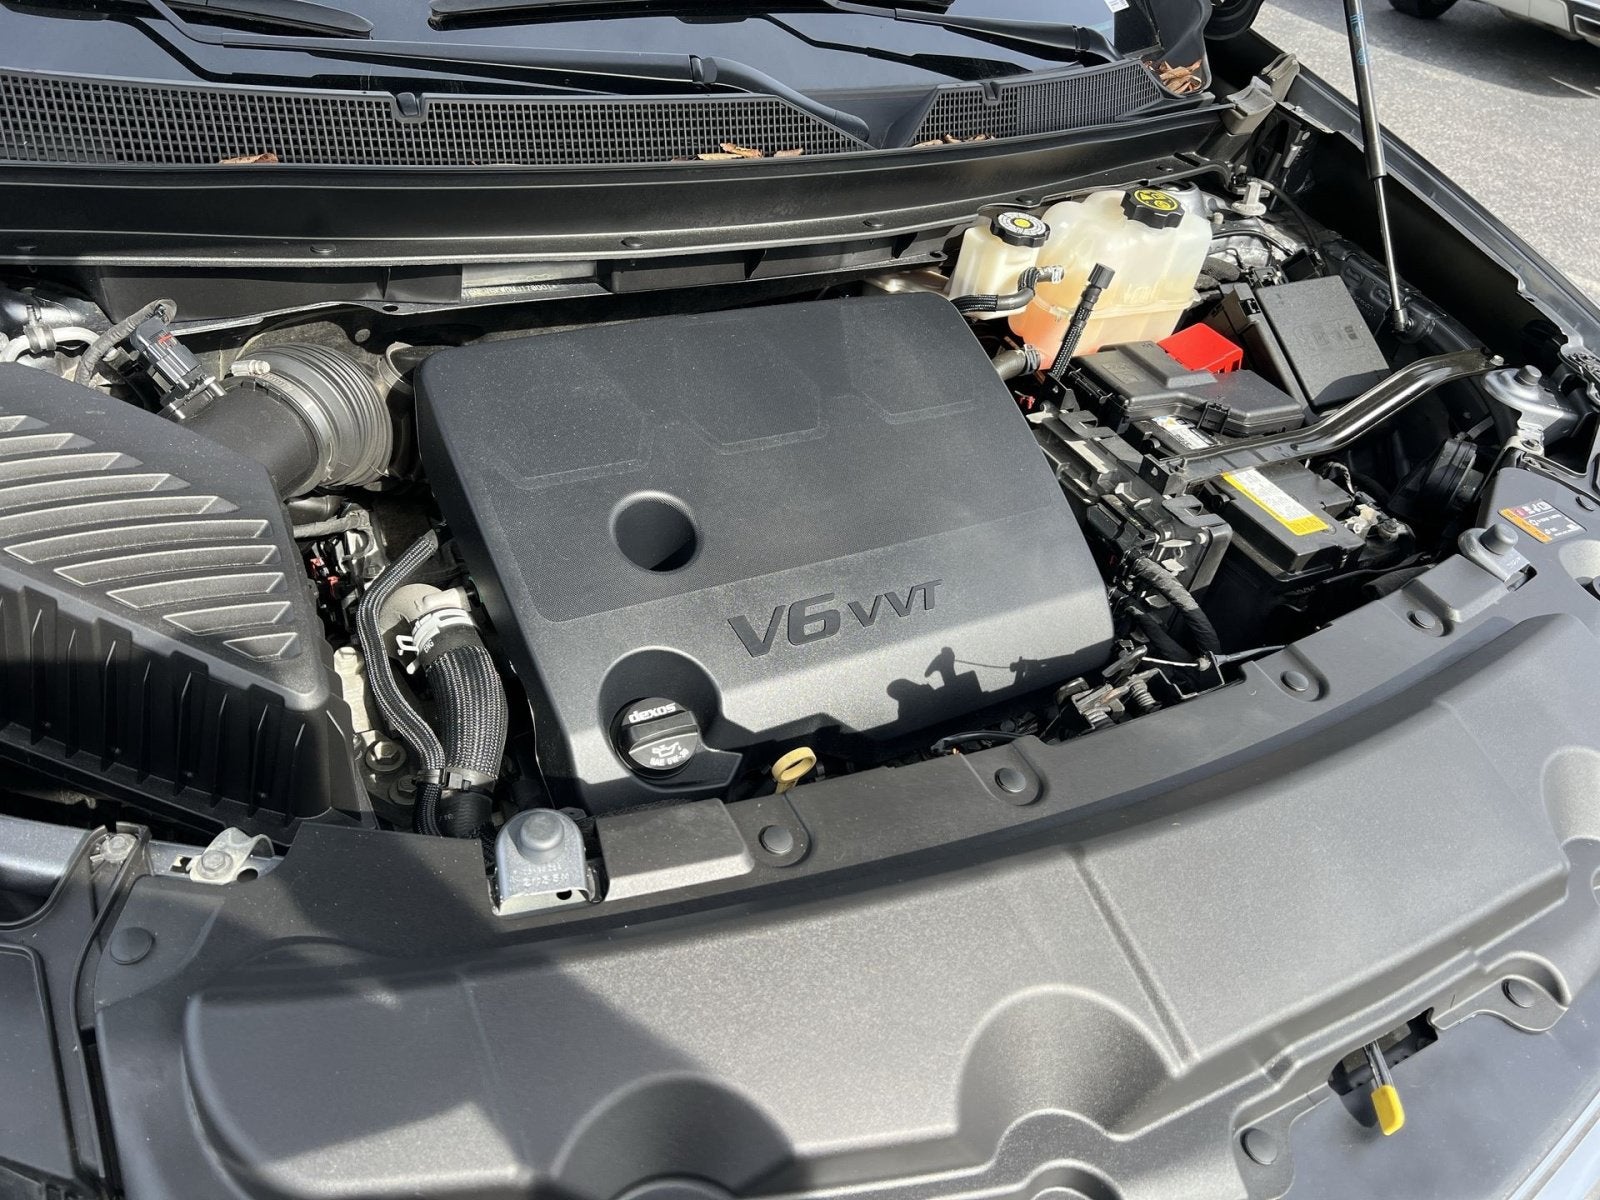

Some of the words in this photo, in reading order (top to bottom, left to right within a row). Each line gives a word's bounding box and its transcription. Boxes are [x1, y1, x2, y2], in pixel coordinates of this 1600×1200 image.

[727, 592, 841, 658] V6
[848, 578, 943, 627] VVT
[628, 702, 676, 723] dexos
[650, 757, 665, 767] SAE
